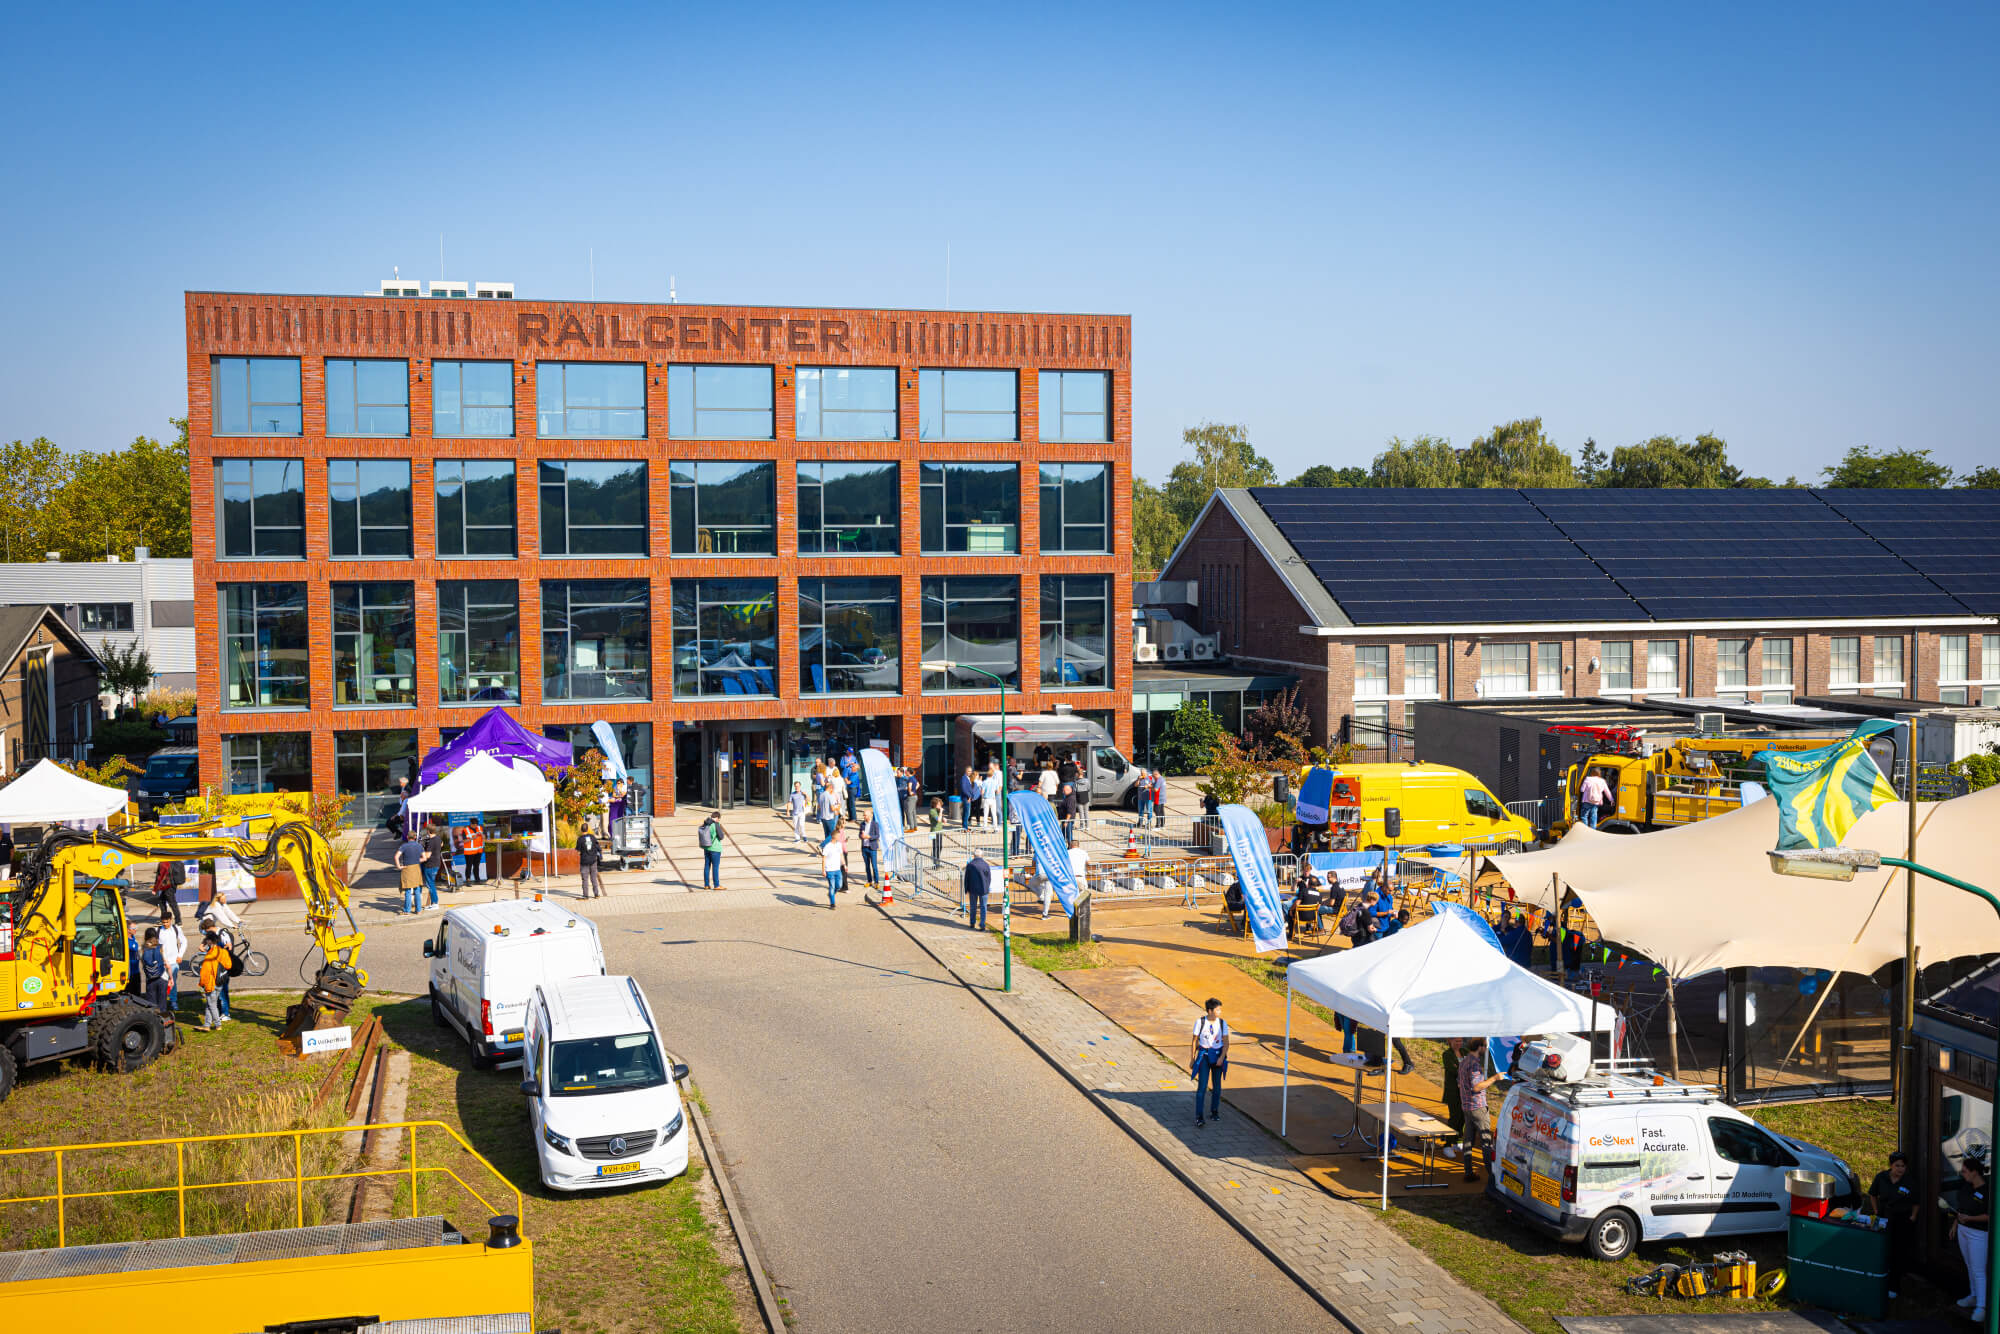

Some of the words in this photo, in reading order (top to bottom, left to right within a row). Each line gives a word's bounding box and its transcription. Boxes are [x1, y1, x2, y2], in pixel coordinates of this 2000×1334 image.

[517, 313, 849, 353] RAILCENTER
[465, 747, 500, 755] alm
[1641, 1128, 1666, 1138] Fast.
[1643, 1142, 1689, 1152] Accurate.
[1650, 1193, 1678, 1201] Building
[1686, 1191, 1729, 1199] Infrastructure
[1731, 1191, 1740, 1199] 3D
[1742, 1190, 1772, 1199] Modelling
